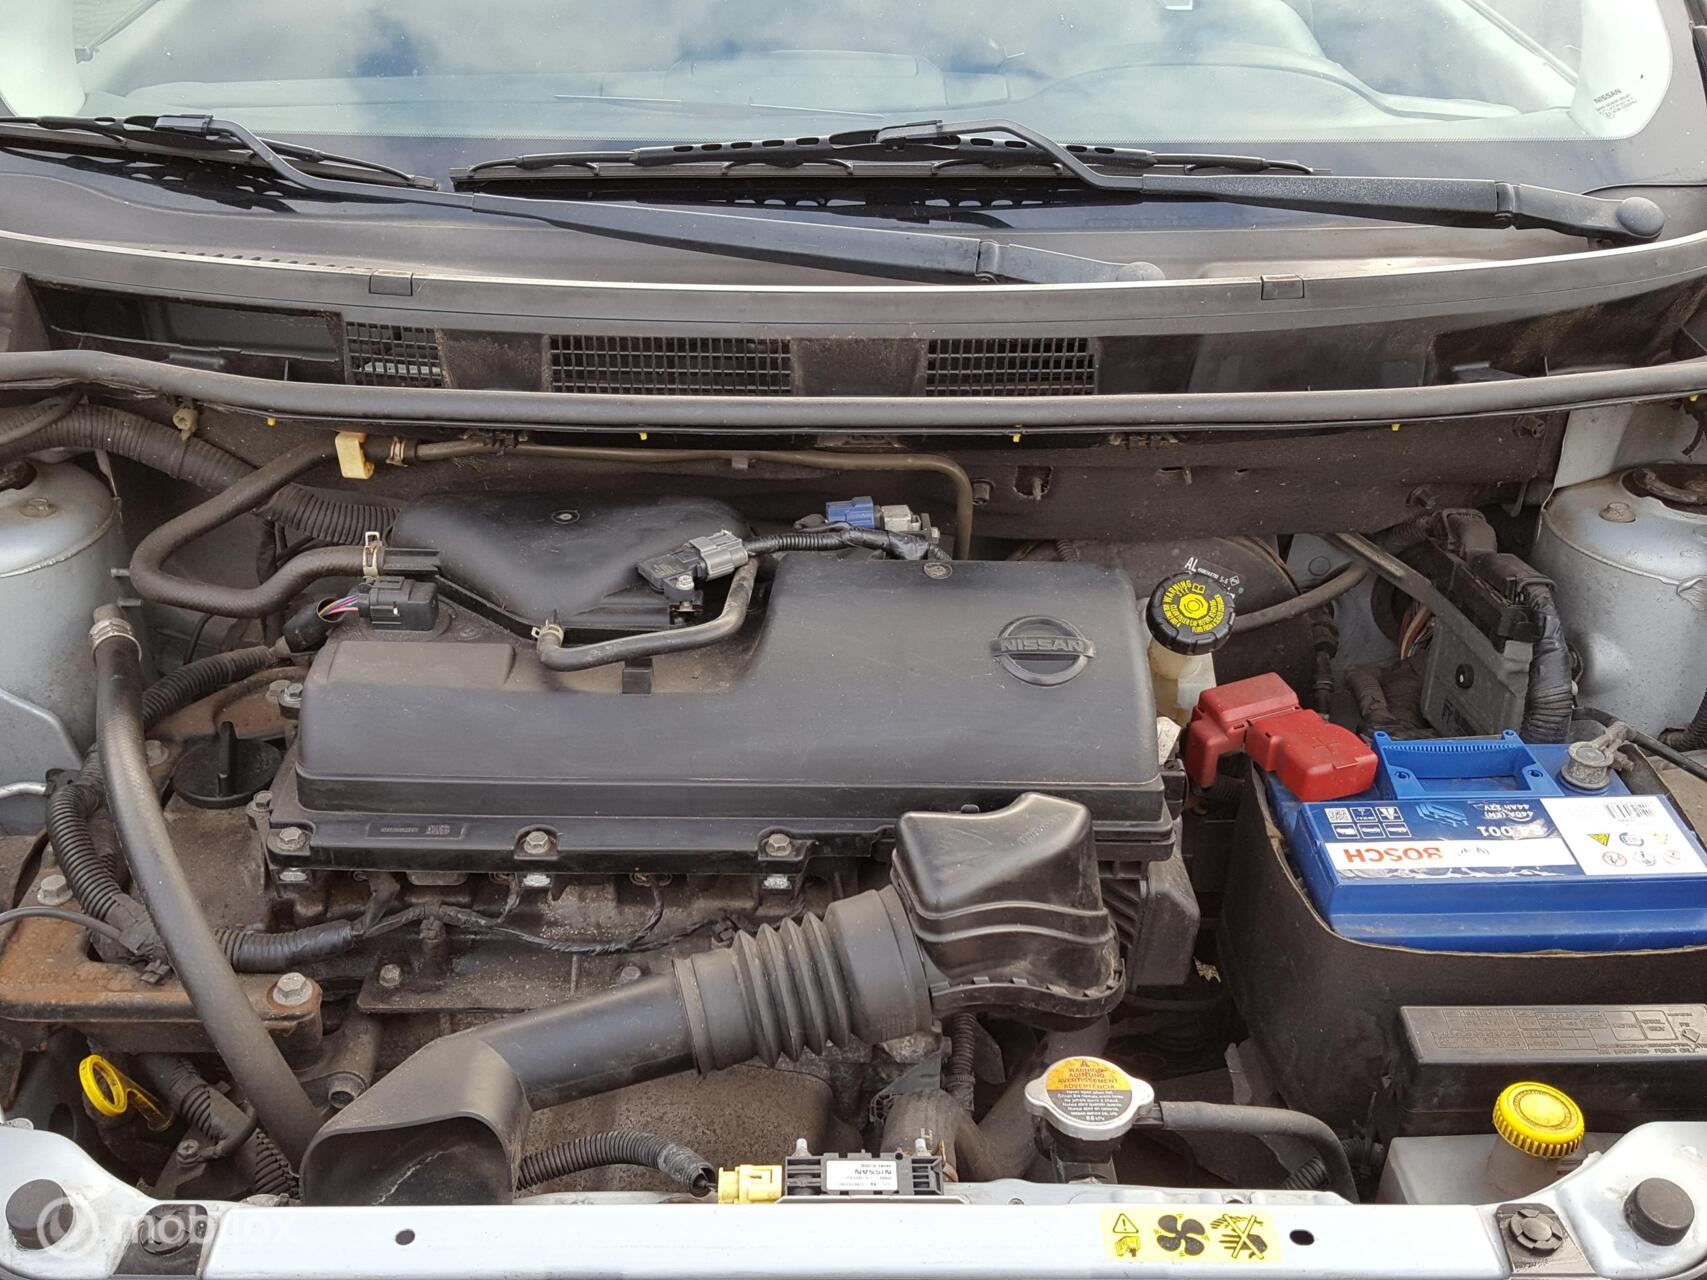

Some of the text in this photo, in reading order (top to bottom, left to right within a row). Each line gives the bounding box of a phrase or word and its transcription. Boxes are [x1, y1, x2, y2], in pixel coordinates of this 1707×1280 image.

[1593, 88, 1622, 103] NISSAN
[1163, 579, 1192, 602] WARNING
[1000, 639, 1084, 651] NISSAN
[1343, 847, 1443, 863] BOSCH
